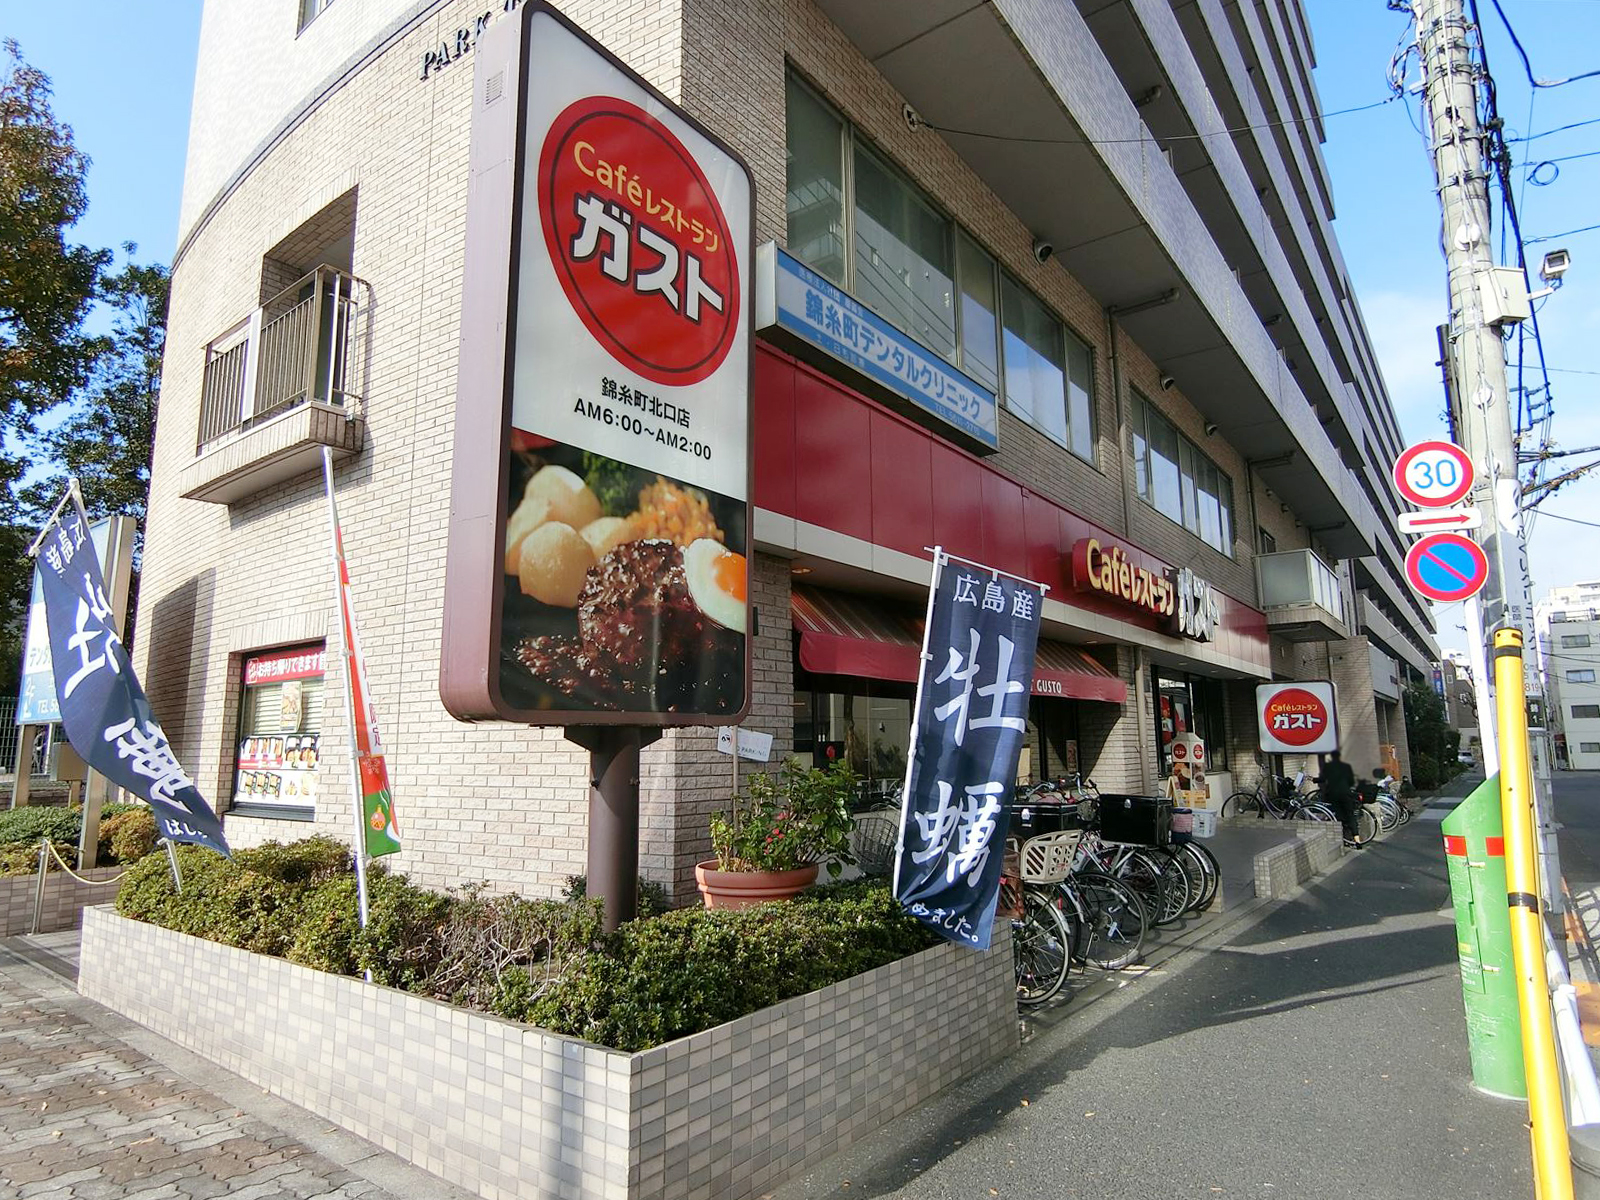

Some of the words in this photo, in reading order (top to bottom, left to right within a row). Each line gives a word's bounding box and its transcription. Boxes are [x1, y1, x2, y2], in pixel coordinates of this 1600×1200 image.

[573, 196, 723, 321] ガスト
[805, 288, 982, 420] 錦糸町デンタルクリニック
[601, 376, 690, 429] 錦糸町北口店
[1413, 459, 1457, 489] 30
[953, 574, 1034, 620] 広島産
[1036, 679, 1062, 694] GUSTO
[1271, 704, 1318, 712] Caféレストラン
[1273, 713, 1321, 729] ガスト
